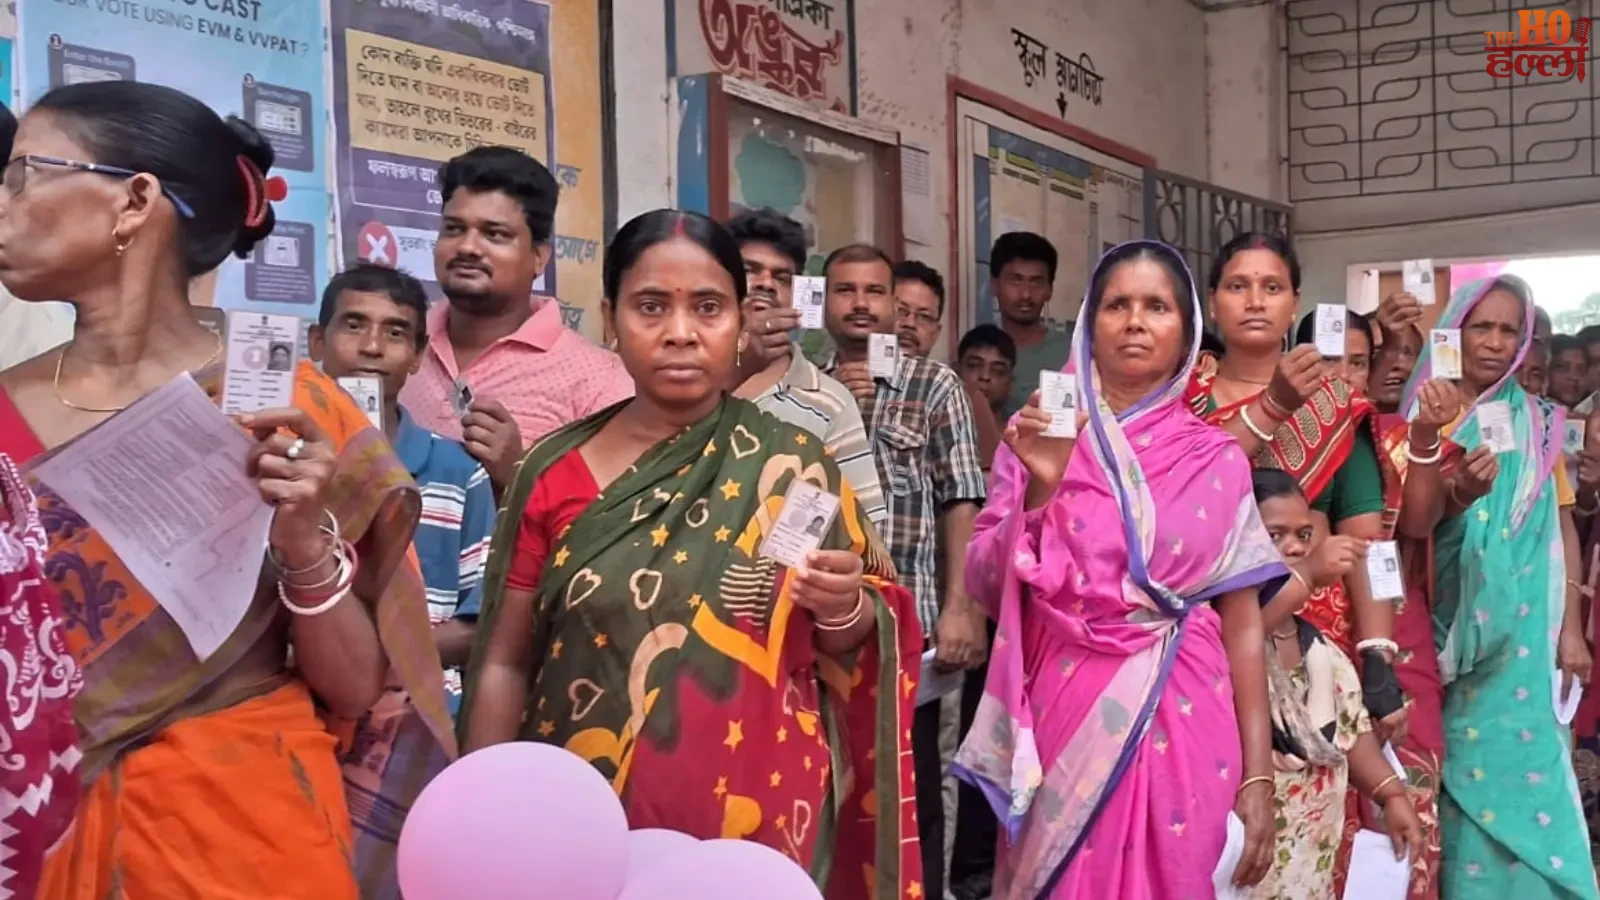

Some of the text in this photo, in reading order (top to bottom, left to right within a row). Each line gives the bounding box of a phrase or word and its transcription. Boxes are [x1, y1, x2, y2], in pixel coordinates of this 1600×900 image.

[96, 0, 140, 20] VOTE
[144, 7, 194, 31] USING
[198, 18, 231, 39] EVM
[234, 27, 244, 43] &
[248, 31, 299, 55] VVPAT
[204, 0, 261, 21] CAST
